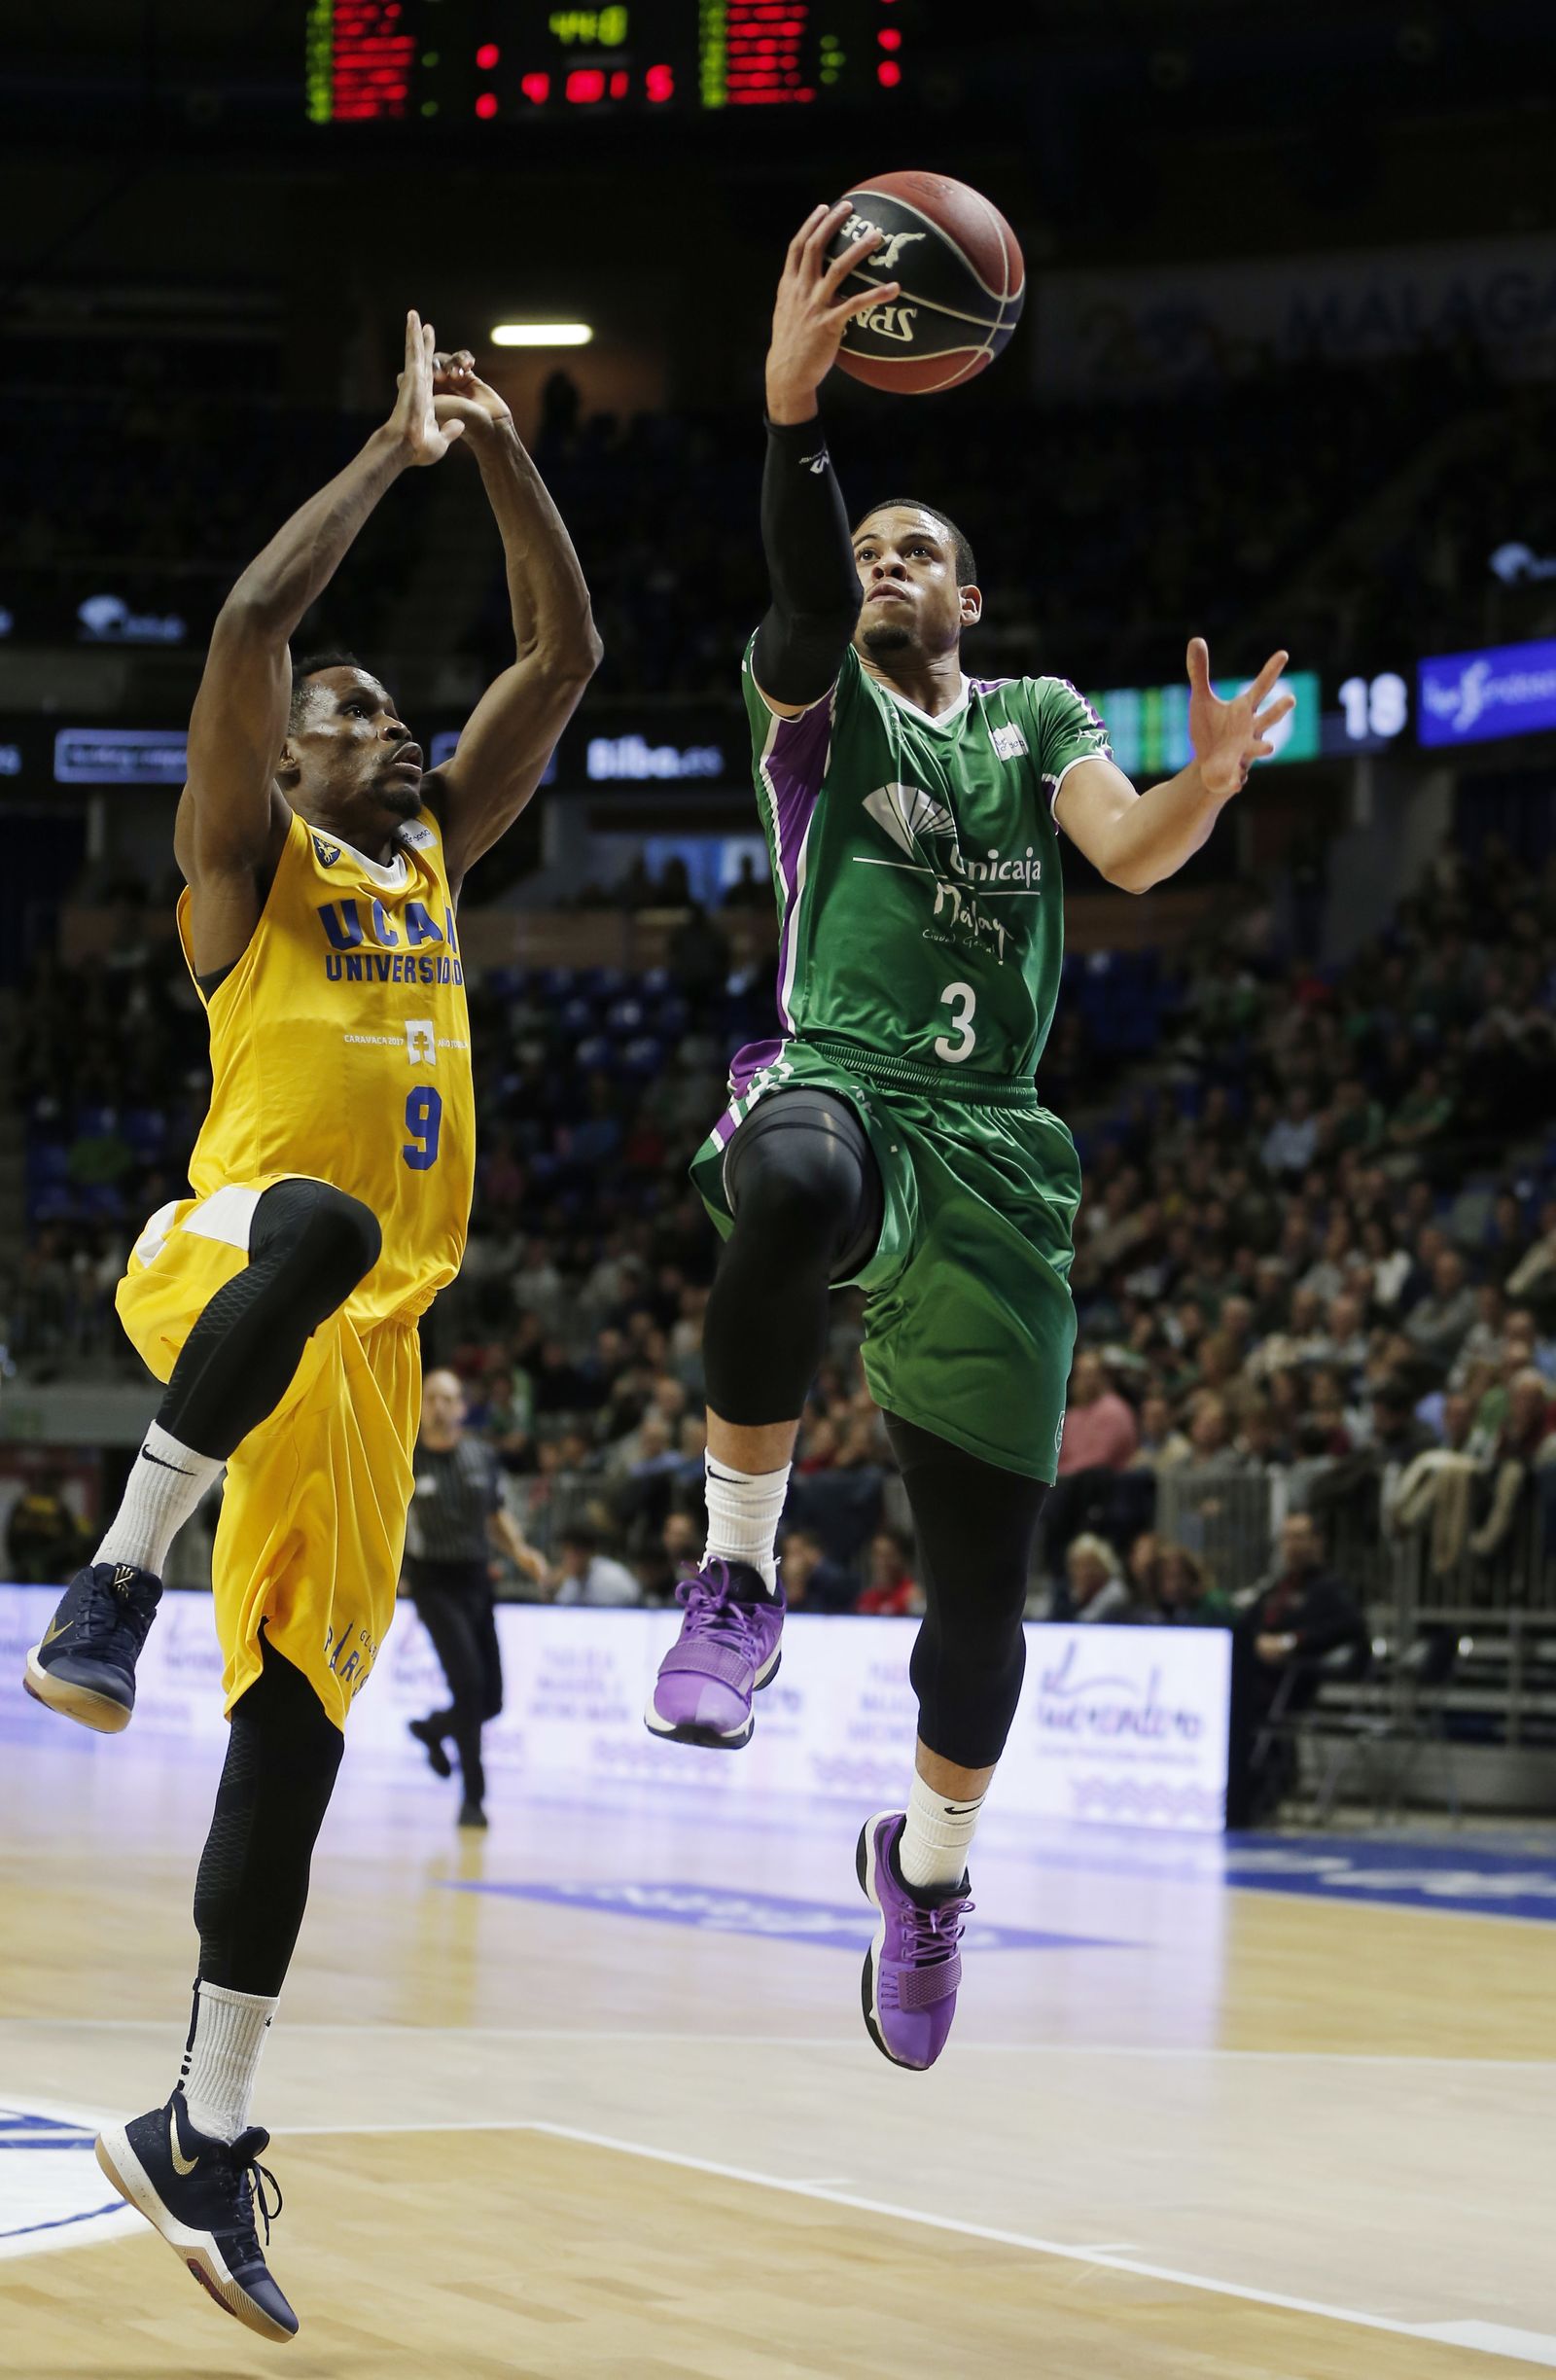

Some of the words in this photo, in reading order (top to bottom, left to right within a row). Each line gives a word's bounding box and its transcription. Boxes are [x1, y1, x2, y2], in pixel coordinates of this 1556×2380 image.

[326, 954, 463, 985] UNIVERSIDD
[343, 1034, 387, 1046] CARAVACA
[935, 981, 976, 1063] 3
[403, 1085, 442, 1170] 9
